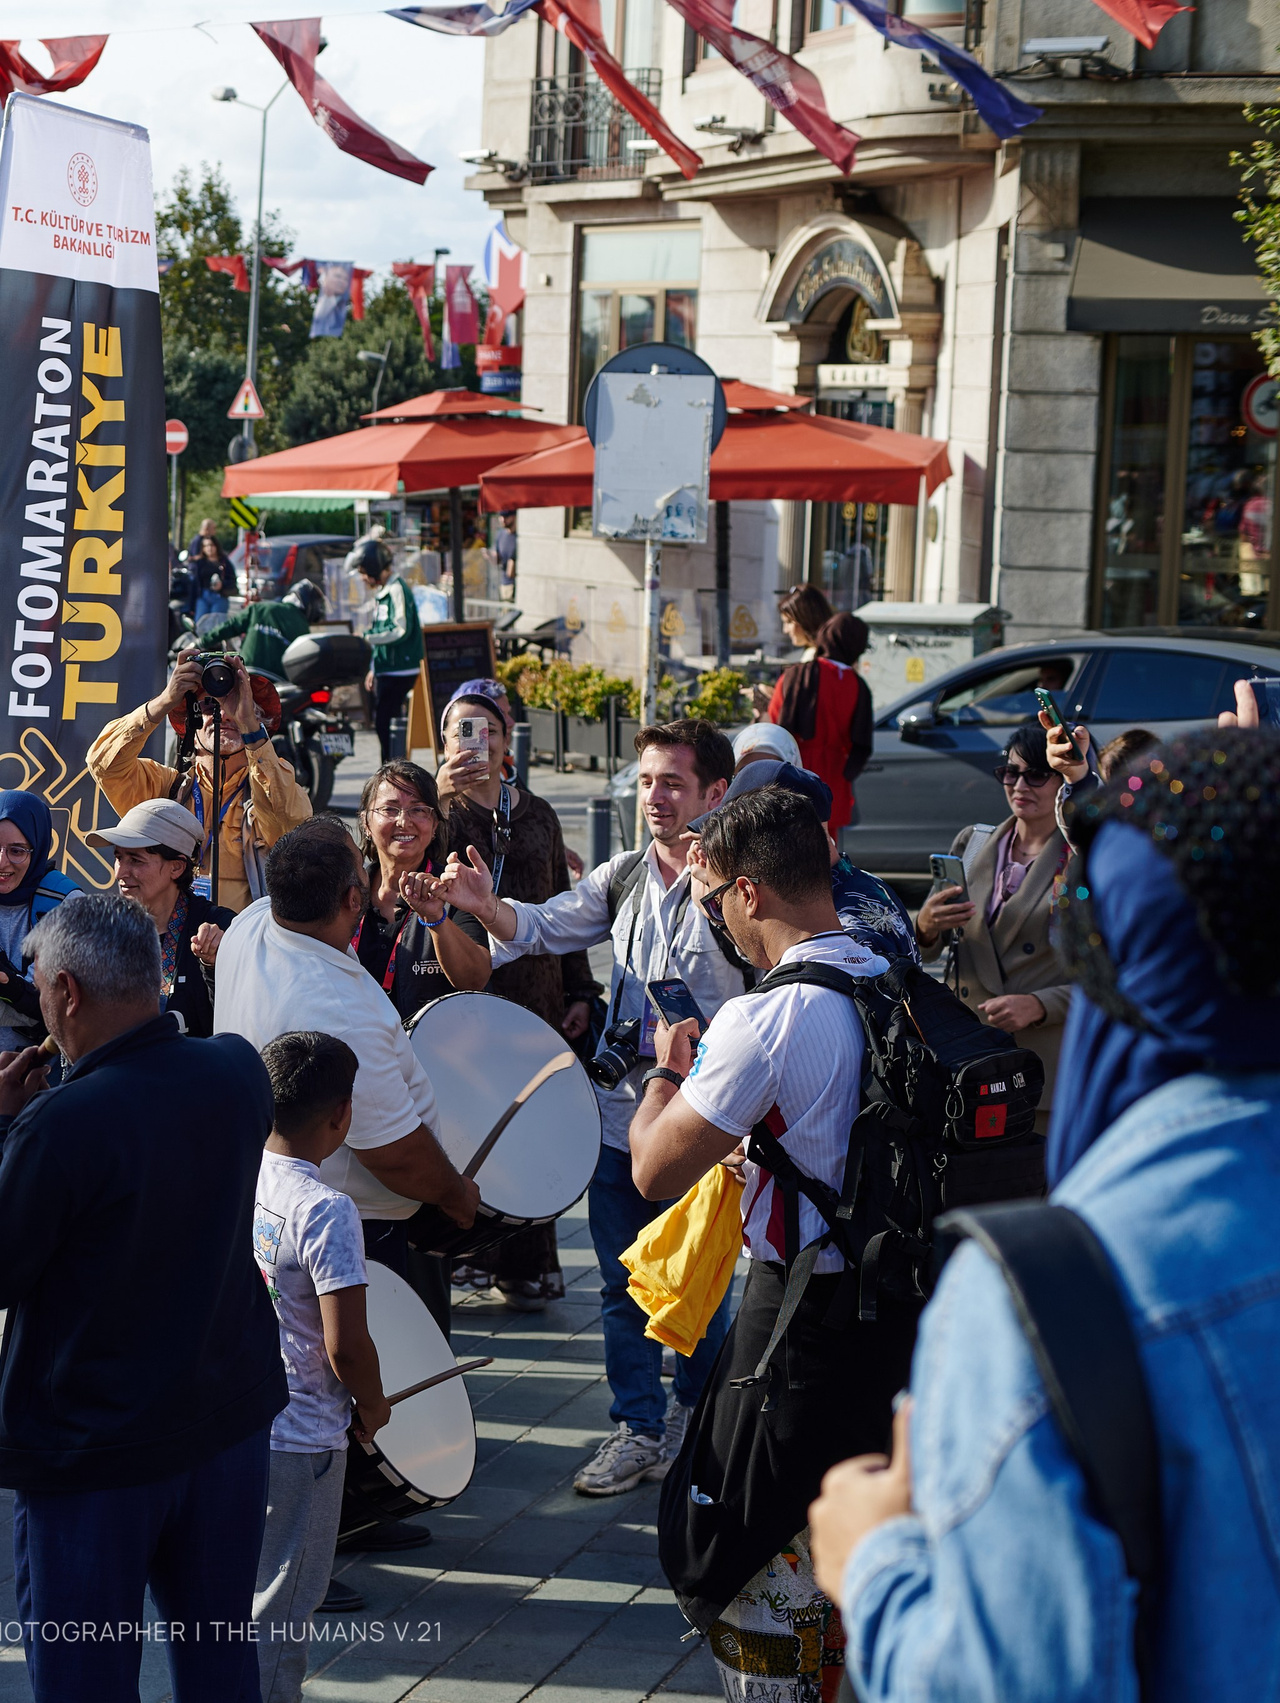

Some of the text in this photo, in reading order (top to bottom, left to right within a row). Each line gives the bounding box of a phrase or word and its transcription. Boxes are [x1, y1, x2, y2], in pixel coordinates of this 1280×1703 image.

[11, 206, 151, 246] T.C. KÜLTÜR VE TURİZM
[52, 234, 115, 259] BAKANLIĞI
[7, 316, 73, 718] FOTOMARATON
